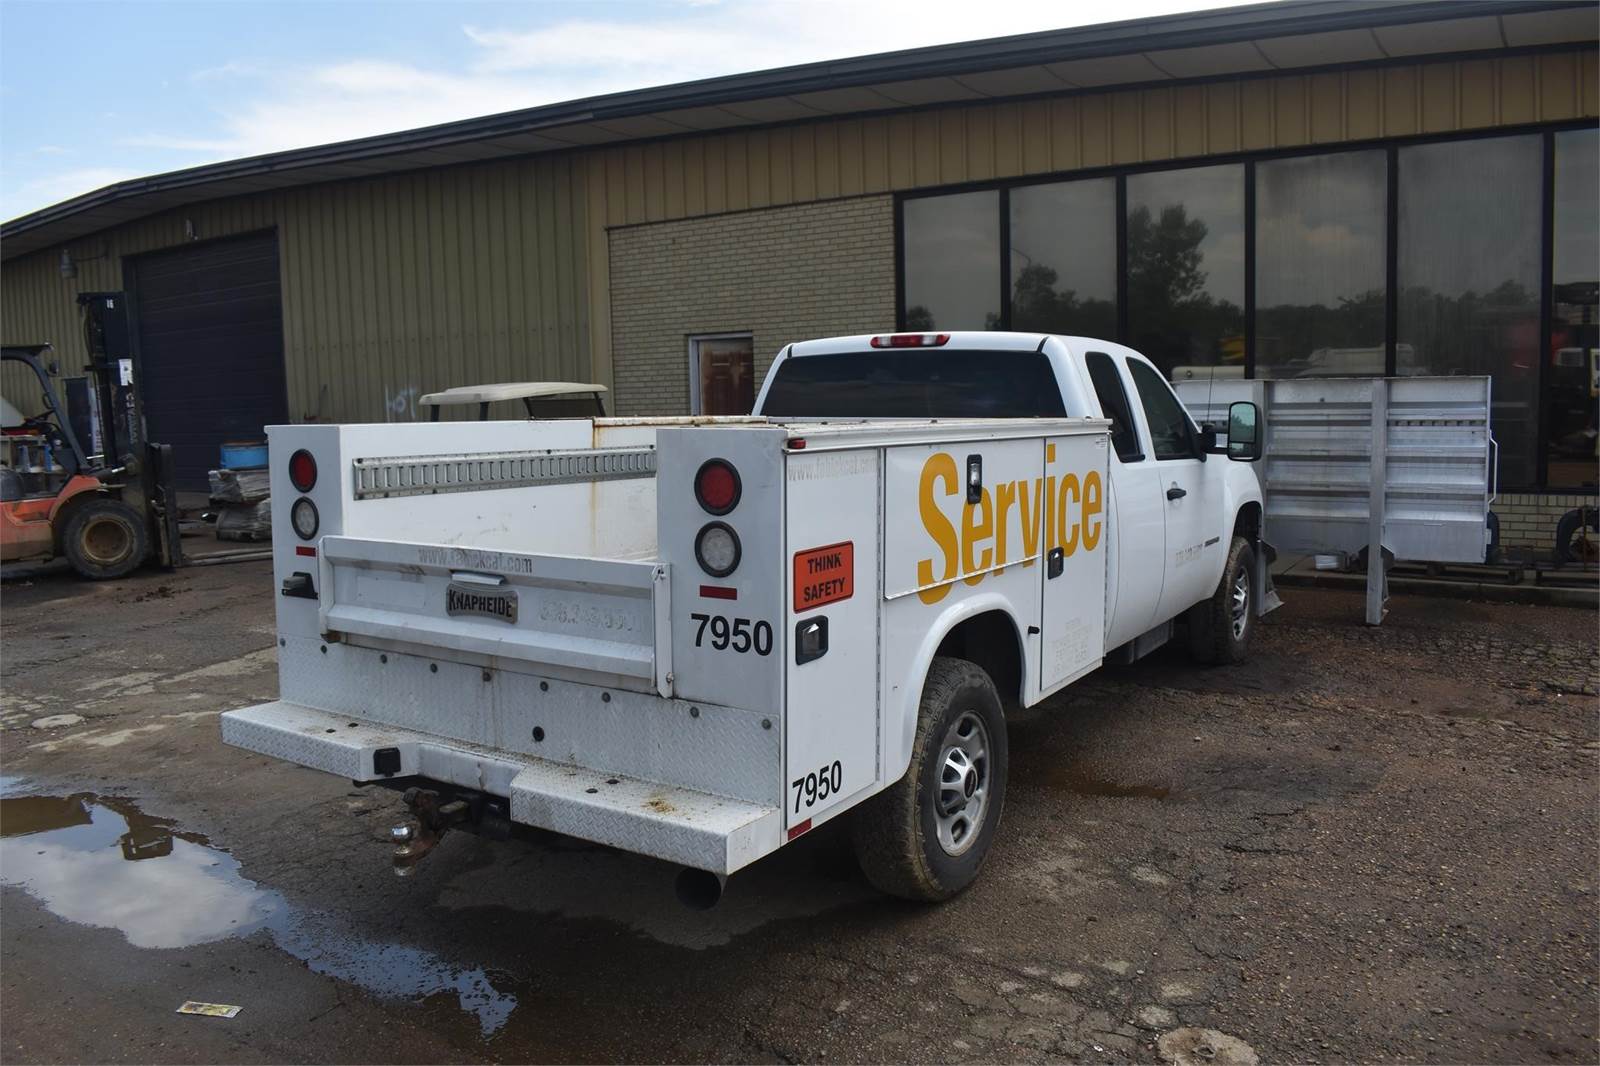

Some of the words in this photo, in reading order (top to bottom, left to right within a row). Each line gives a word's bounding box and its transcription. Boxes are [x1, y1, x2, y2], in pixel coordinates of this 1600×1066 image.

[917, 443, 1103, 605] Service
[807, 552, 842, 575] THINK
[448, 589, 513, 618] KNAPHEIDE
[803, 577, 846, 602] SAFETY
[691, 613, 773, 656] 7950
[792, 760, 842, 814] 7950
